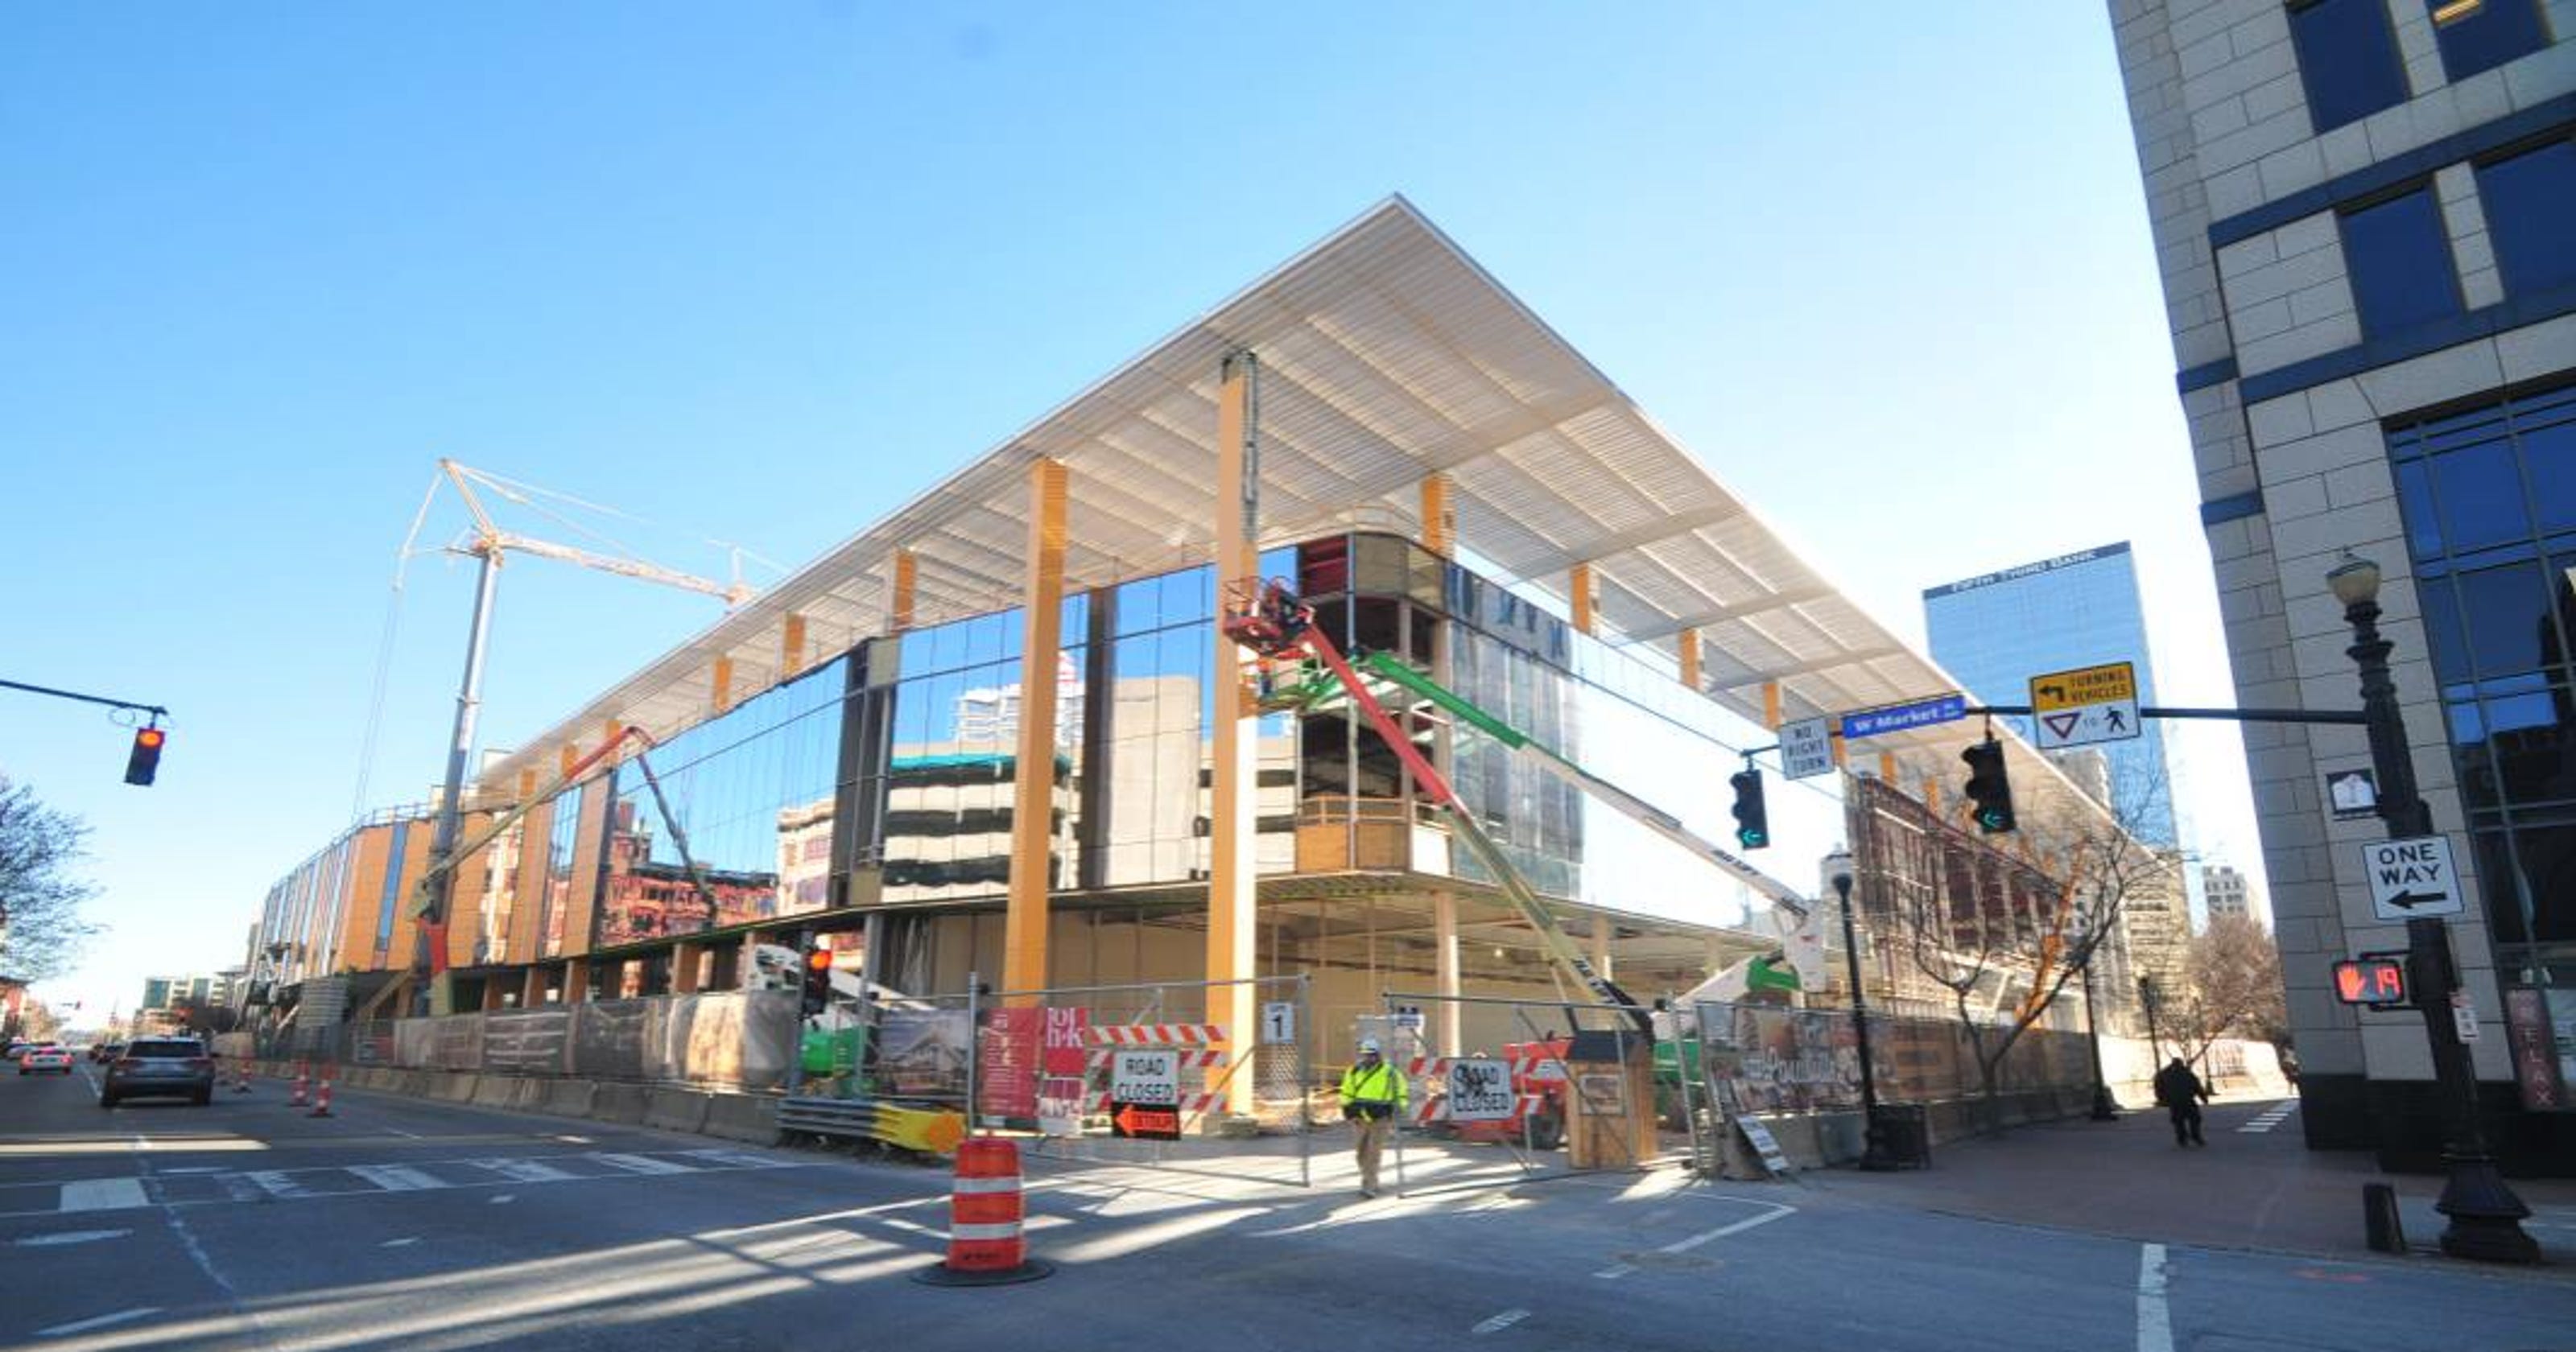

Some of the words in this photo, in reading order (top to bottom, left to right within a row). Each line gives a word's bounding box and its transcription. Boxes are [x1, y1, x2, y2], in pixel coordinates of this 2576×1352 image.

[2050, 550, 2097, 571] BANK
[2070, 669, 2128, 689] TURNING
[2071, 683, 2128, 703] VEHICLES
[1856, 719, 1872, 732] W
[1876, 707, 1938, 727] Market
[1794, 728, 1812, 739] NO
[1788, 740, 1824, 757] RIGHT
[1794, 757, 1826, 773] TURN
[2379, 843, 2438, 865] ONE
[2380, 863, 2441, 885] WAY
[2376, 966, 2401, 996] 19
[1272, 1014, 1282, 1037] 1
[1125, 1058, 1166, 1076] ROAD
[1117, 1082, 1172, 1101] CLOSED
[1454, 1092, 1509, 1111] CLOSED
